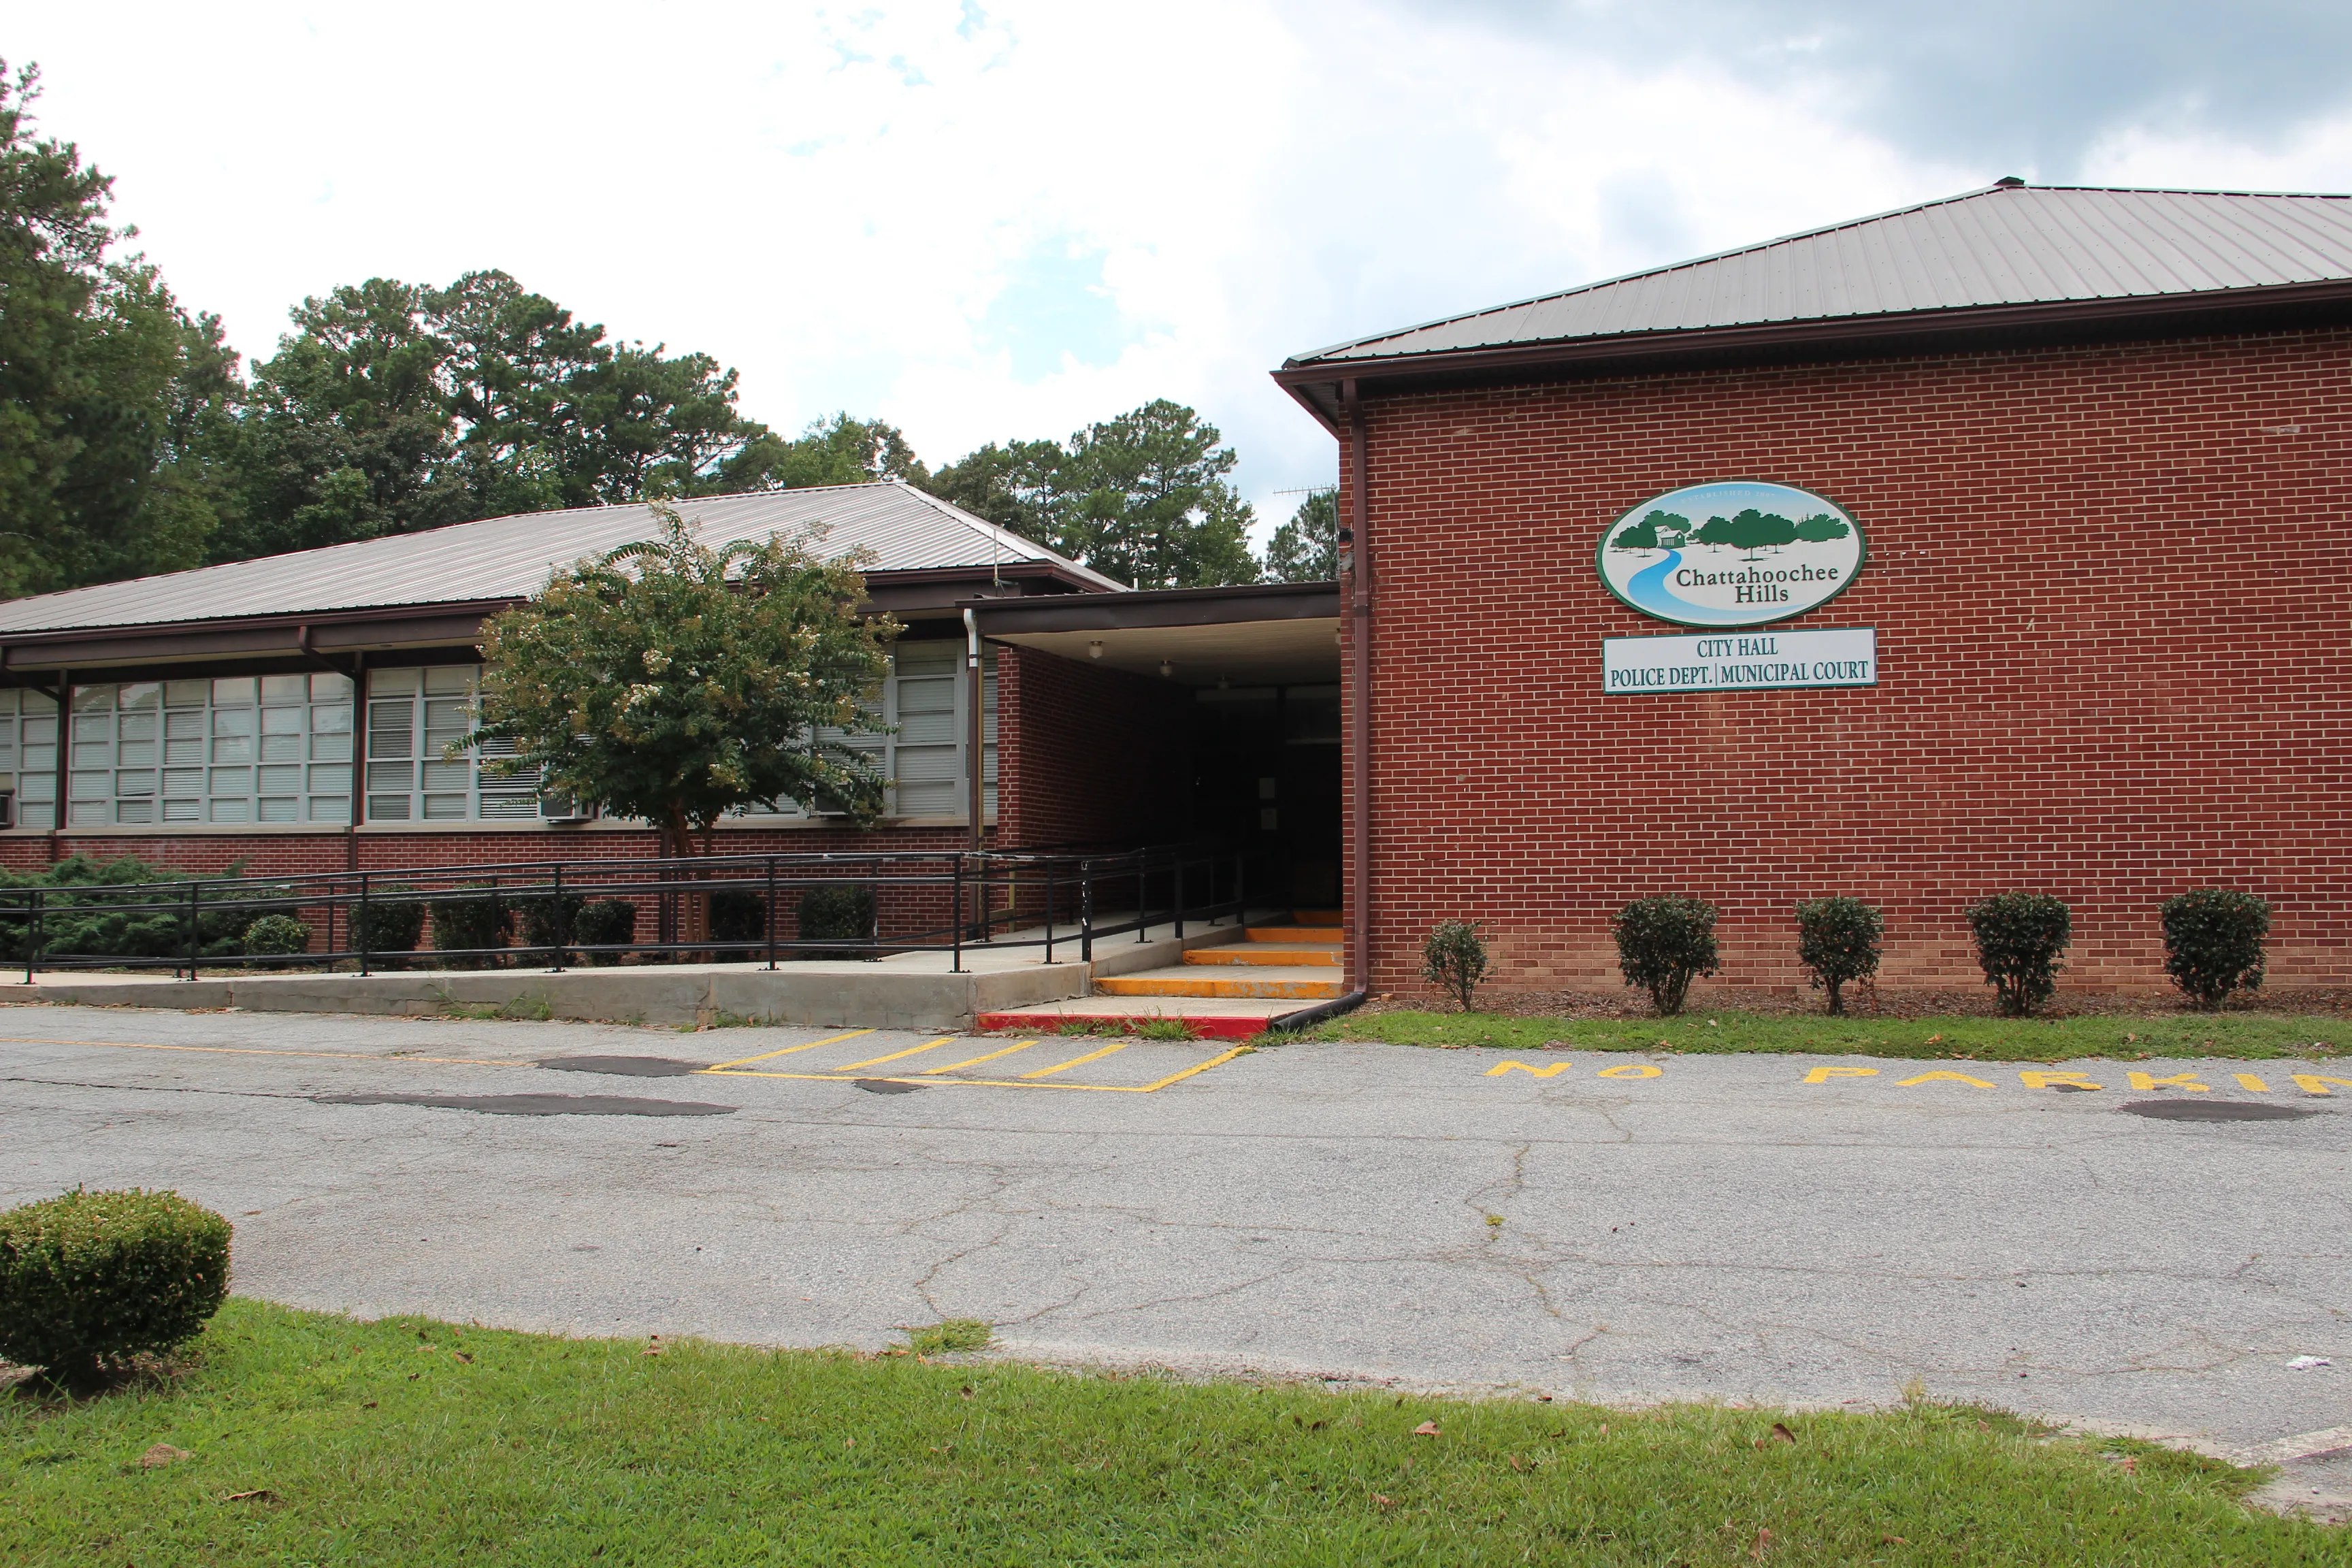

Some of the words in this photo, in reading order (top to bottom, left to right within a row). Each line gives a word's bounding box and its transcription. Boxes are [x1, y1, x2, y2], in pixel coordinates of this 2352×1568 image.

[1680, 490, 1750, 504] ESTABLISHED
[1676, 564, 1838, 587] Chattahoochee
[1735, 585, 1788, 603] Hills
[1697, 640, 1733, 657] CITY
[1737, 638, 1778, 656] HALL
[1610, 668, 1665, 687] POLICE
[1669, 666, 1712, 685] DEPT.
[1720, 663, 1810, 683] MUNICIPAL
[1813, 661, 1868, 680] COURT
[1482, 1060, 1663, 1079] NO
